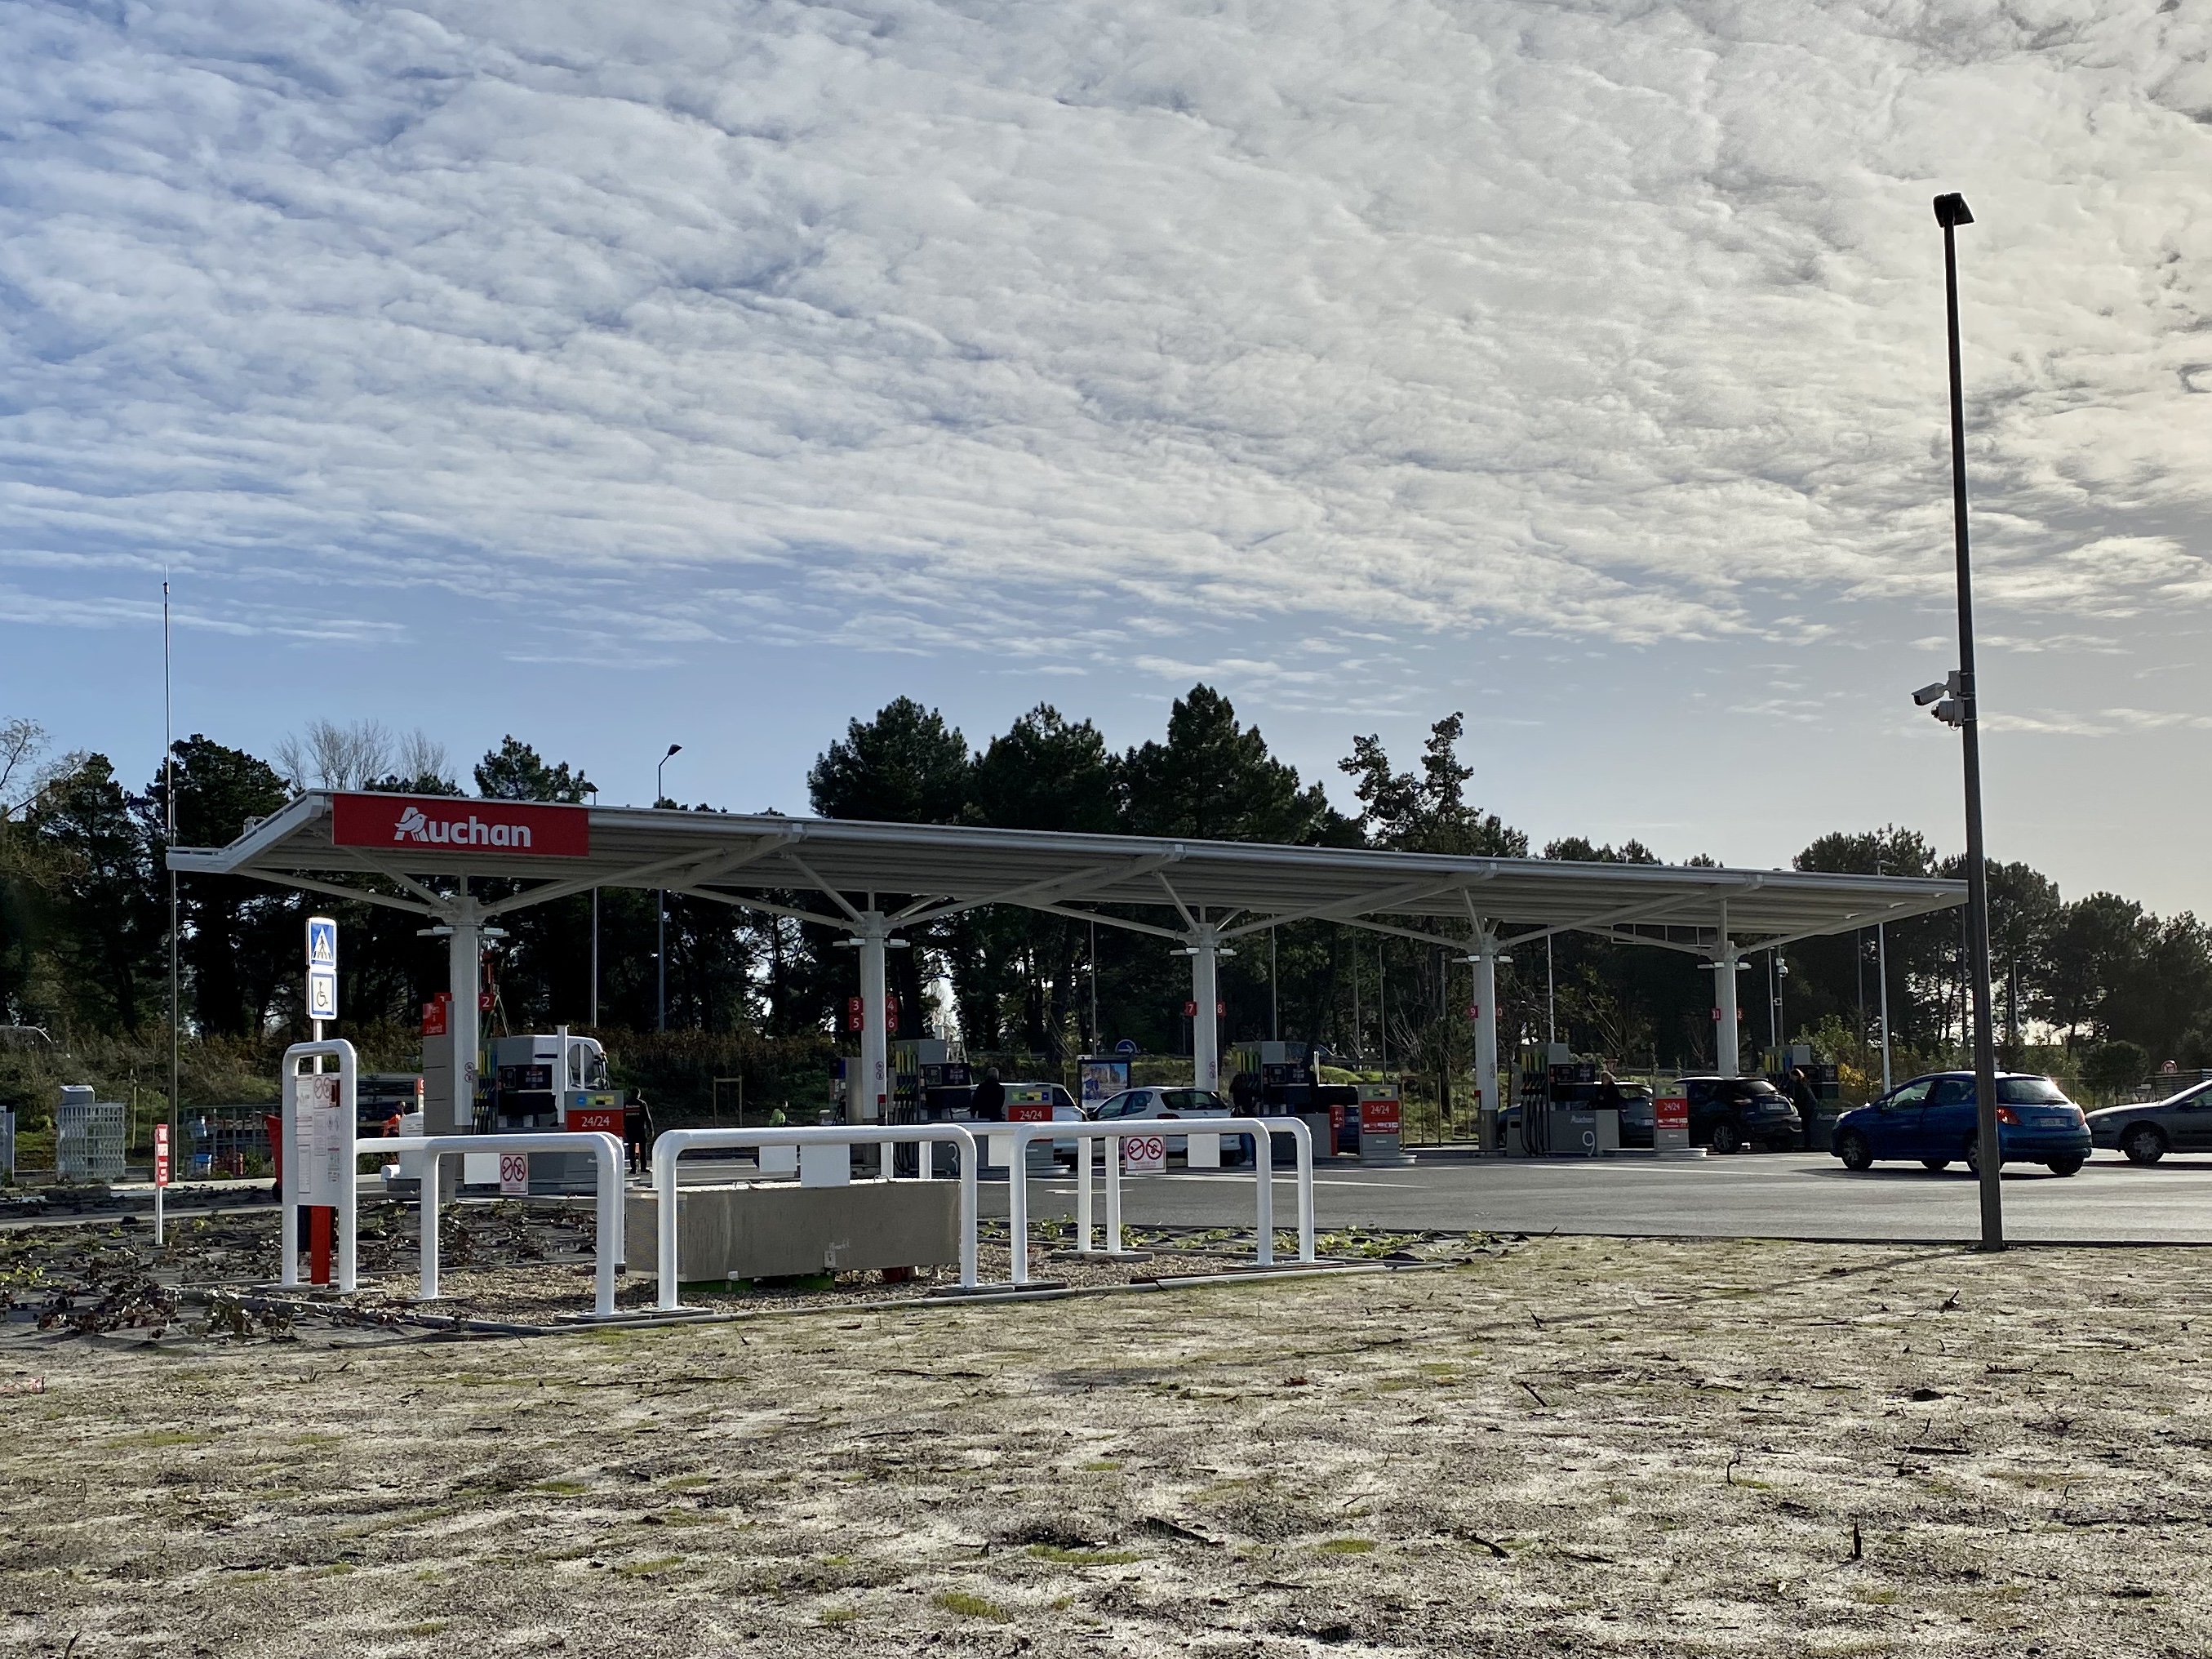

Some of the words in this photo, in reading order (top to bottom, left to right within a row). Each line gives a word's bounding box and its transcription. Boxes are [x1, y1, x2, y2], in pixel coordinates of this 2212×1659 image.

[393, 807, 531, 847] Auchan
[482, 997, 490, 1007] 2
[853, 1000, 859, 1011] 3
[887, 1001, 895, 1010] 4
[1188, 1004, 1194, 1013] 7
[1217, 1004, 1223, 1013] 8
[1470, 1007, 1476, 1016] 9
[853, 1017, 859, 1028] 5
[888, 1018, 895, 1028] 6
[1370, 1105, 1390, 1114] 24/24
[1663, 1102, 1681, 1111] 24/24
[1019, 1110, 1043, 1121] 24/24
[581, 1115, 611, 1127] 24/24
[1582, 1130, 1596, 1157] 9
